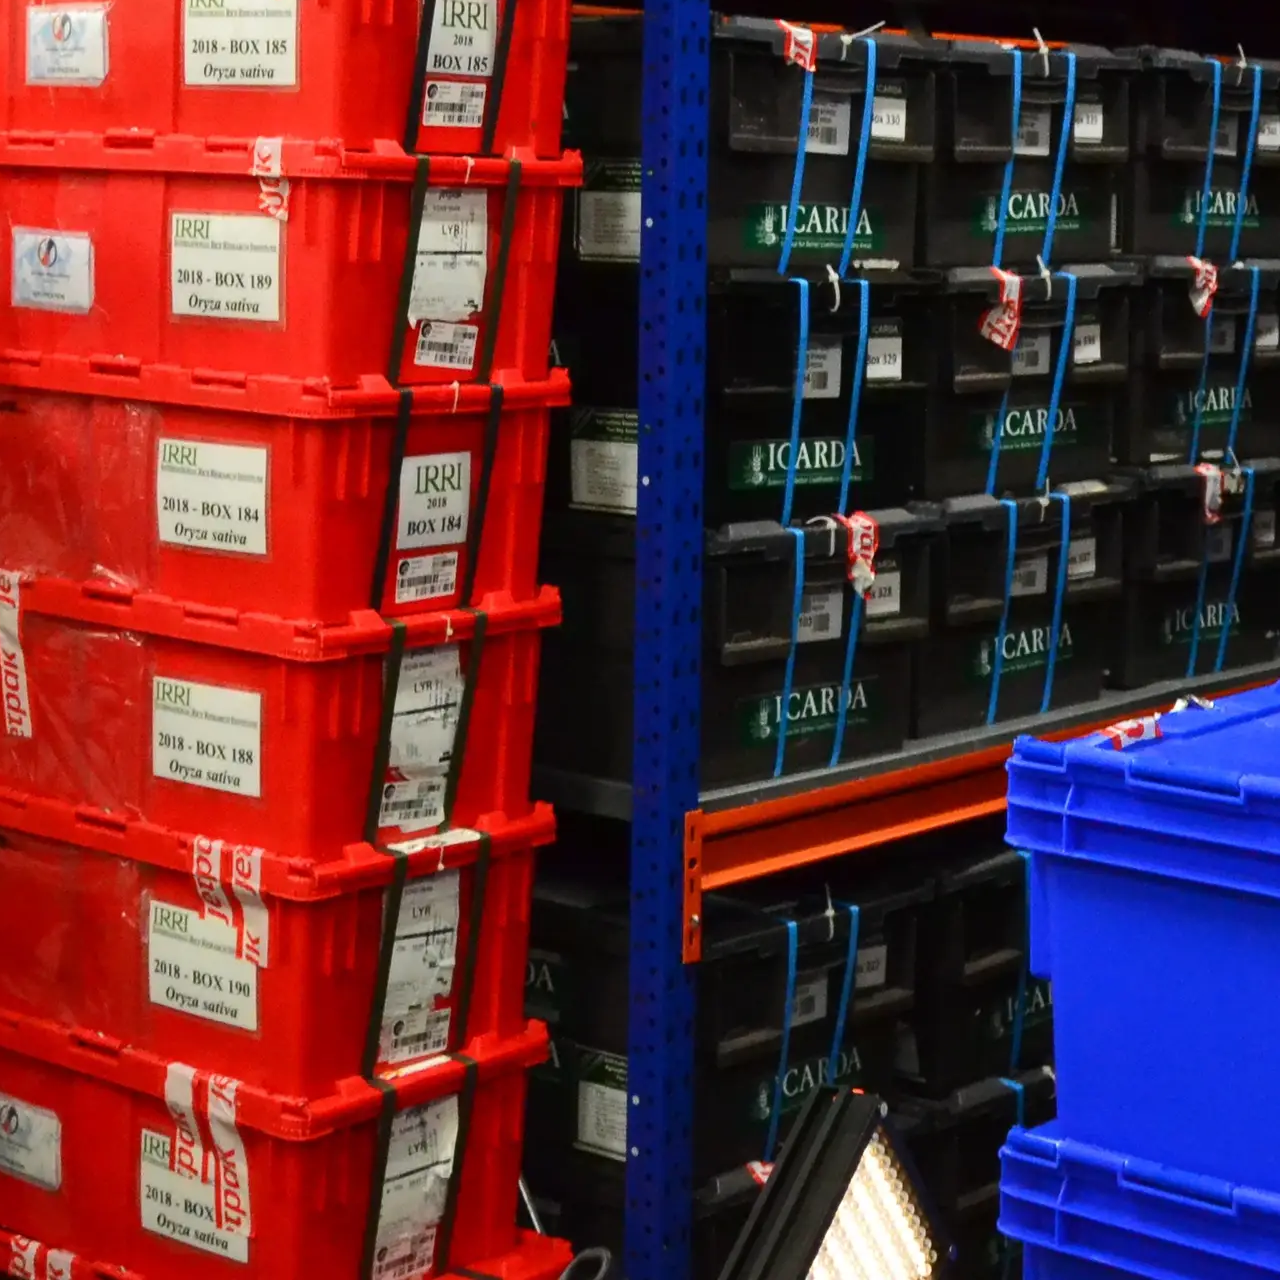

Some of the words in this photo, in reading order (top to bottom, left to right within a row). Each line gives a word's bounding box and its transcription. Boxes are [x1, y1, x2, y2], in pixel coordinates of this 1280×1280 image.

[192, 39, 218, 55] 2018
[230, 39, 260, 55] BOX
[265, 39, 288, 55] 185
[453, 34, 474, 47] 2018
[203, 63, 237, 83] Oryza
[239, 64, 275, 81] sativa
[432, 54, 462, 71] BOX
[466, 54, 489, 73] 185
[1007, 192, 1080, 221] CARDA
[175, 218, 210, 240] IRRI
[177, 269, 203, 285] 2018
[215, 271, 245, 288] BOX
[250, 274, 273, 291] 189
[188, 293, 221, 313] Oryza
[225, 296, 260, 314] sativa
[1188, 385, 1253, 413] ICARA
[162, 442, 198, 467] IRRI
[767, 439, 863, 471] ICARDA
[414, 462, 463, 495] IRRI
[162, 496, 189, 513] 2018
[201, 501, 232, 520] BOX
[236, 506, 260, 524] 184
[426, 497, 448, 511] 2018
[174, 522, 208, 542] Oryza
[212, 527, 247, 546] sativa
[406, 518, 437, 536] BOX
[440, 514, 462, 533] 184
[995, 621, 1074, 661] ICARA
[156, 680, 192, 707] IRRI
[158, 732, 185, 751] 2018
[196, 739, 227, 760] BOX
[232, 745, 254, 765] 188
[169, 758, 202, 780] Oryza
[206, 765, 241, 787] sativa
[154, 906, 188, 933] IRRI
[154, 959, 181, 980] 2018
[192, 969, 224, 992] BOX
[229, 978, 251, 998] 190
[165, 986, 199, 1010] Oryza
[202, 996, 238, 1019] sativa
[781, 1046, 863, 1098] CARDA
[145, 1185, 173, 1207] 2018
[183, 1196, 214, 1222] BOX
[156, 1212, 191, 1237] Oryza
[194, 1226, 229, 1251] sativa
